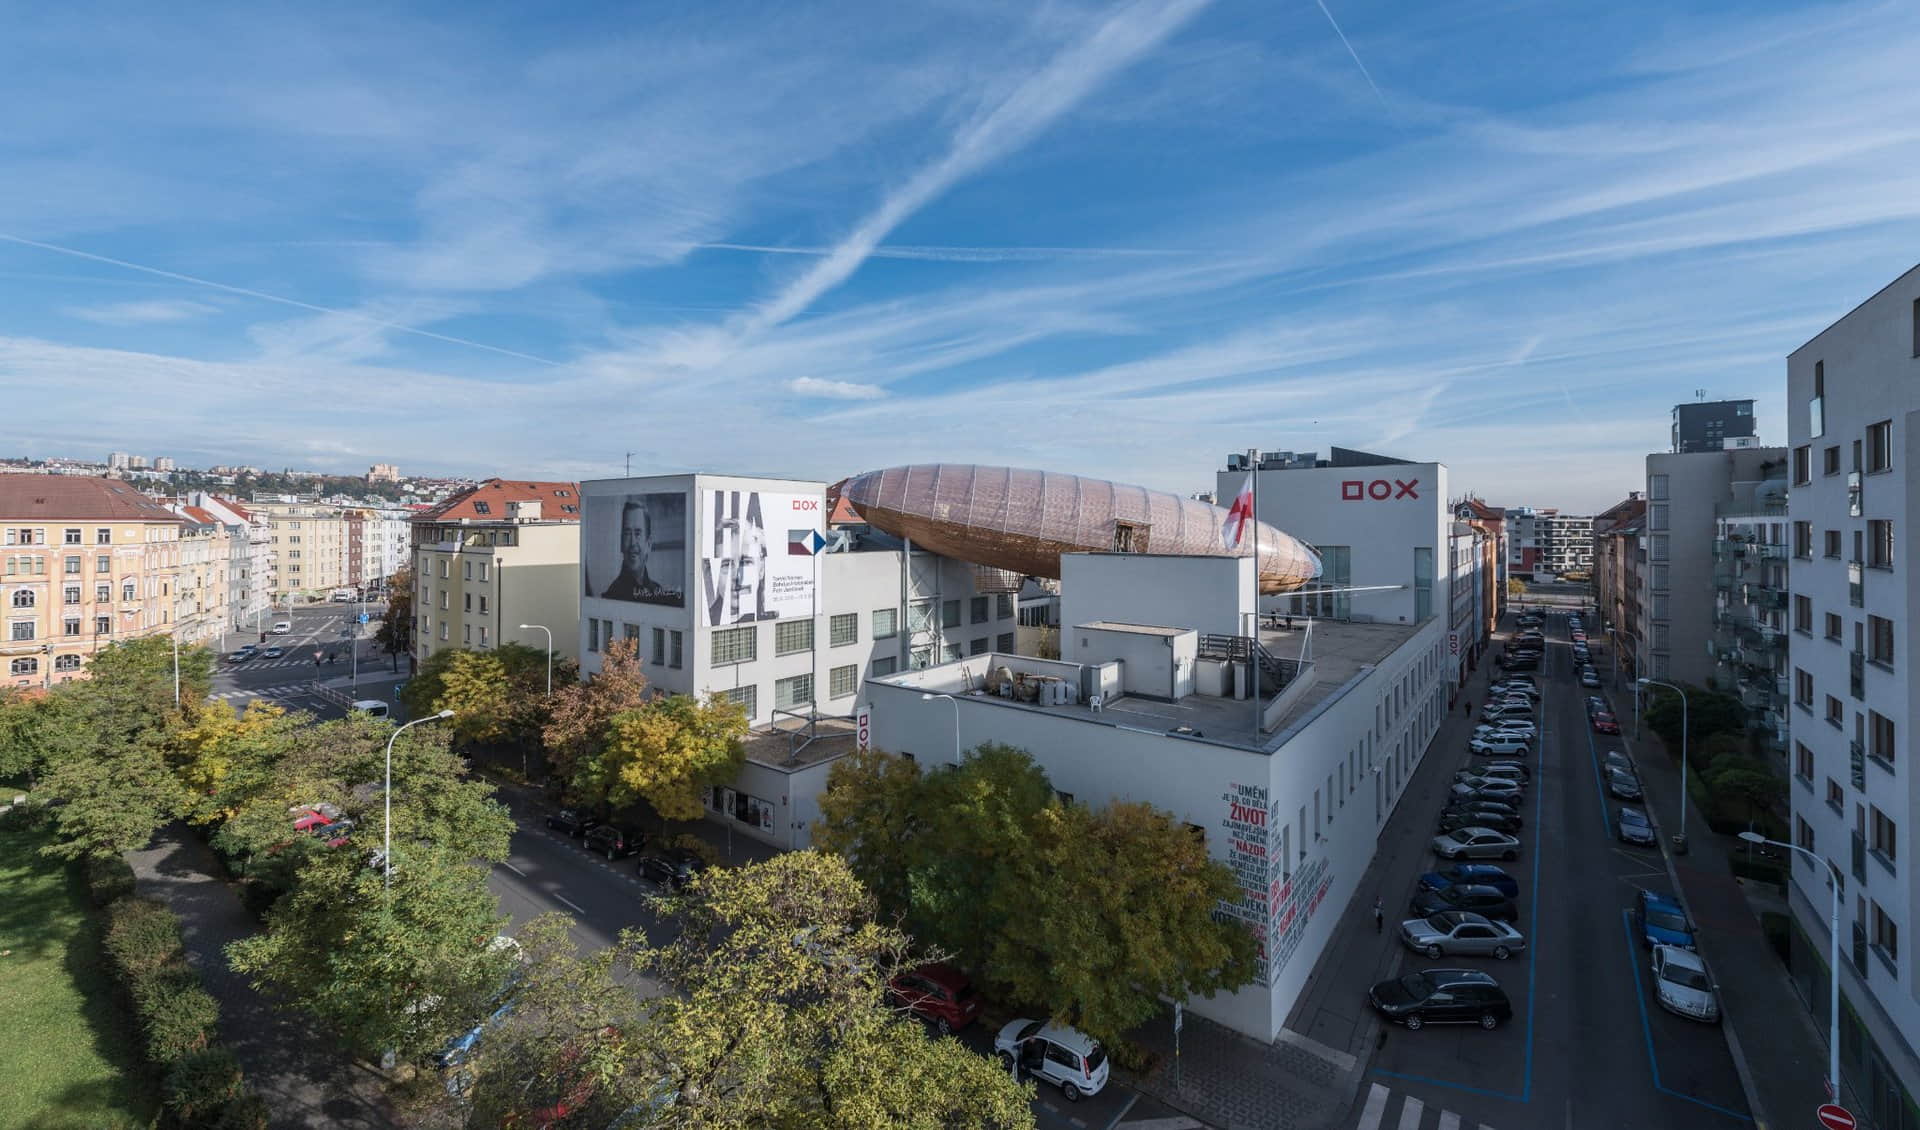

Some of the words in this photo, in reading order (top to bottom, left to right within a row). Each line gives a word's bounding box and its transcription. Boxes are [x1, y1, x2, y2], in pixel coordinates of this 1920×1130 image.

[1342, 479, 1419, 500] DOX
[793, 500, 818, 509] DOX
[1231, 801, 1267, 826] ŽIVOT
